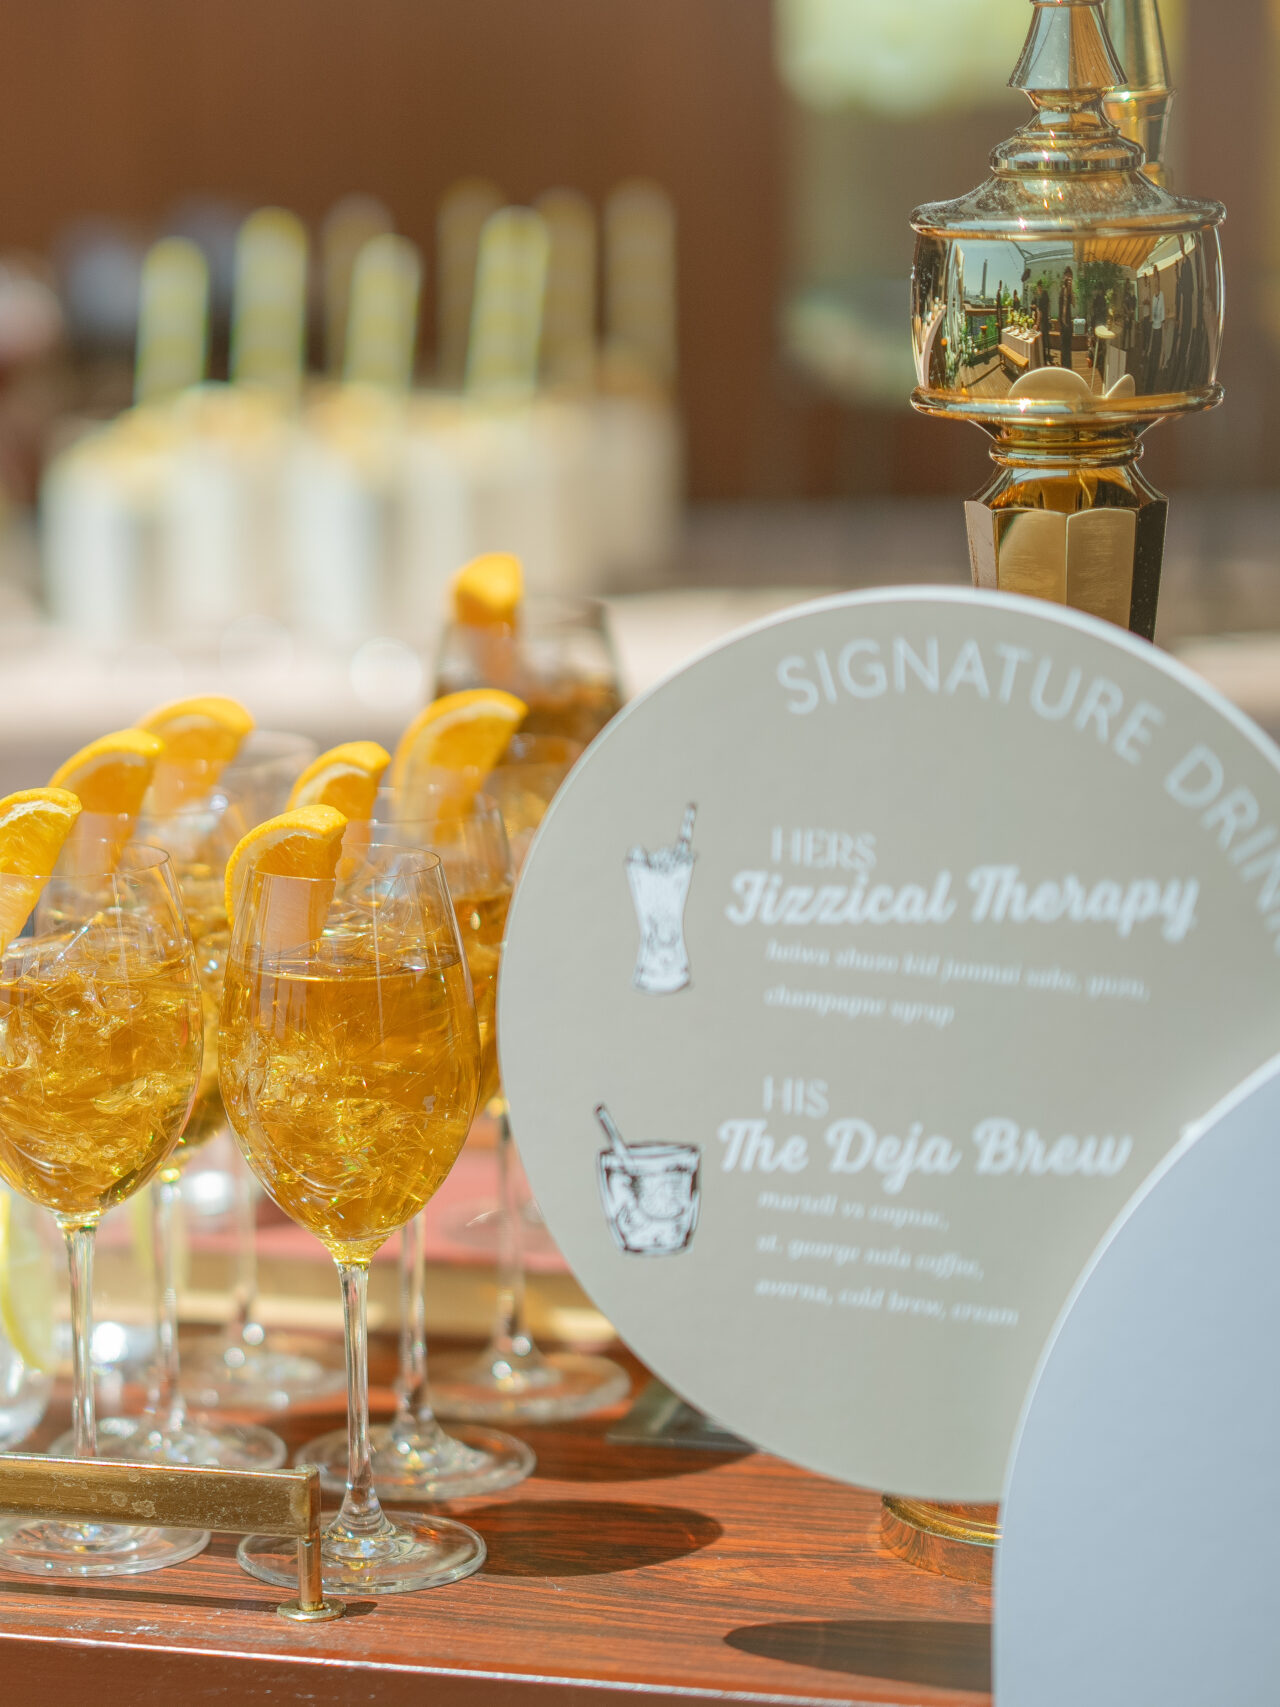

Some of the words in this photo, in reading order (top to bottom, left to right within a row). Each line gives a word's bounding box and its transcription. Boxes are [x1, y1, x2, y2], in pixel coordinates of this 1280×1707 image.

[777, 636, 1166, 765] SIGNATURE
[1165, 743, 1280, 956] DRIN
[771, 826, 877, 869] HERS
[726, 869, 957, 924] Fizzical
[967, 864, 1200, 942] Therapy
[763, 1076, 830, 1118] HIS
[719, 1118, 809, 1173] The
[824, 1117, 962, 1195] Deja
[973, 1117, 1134, 1176] Brew
